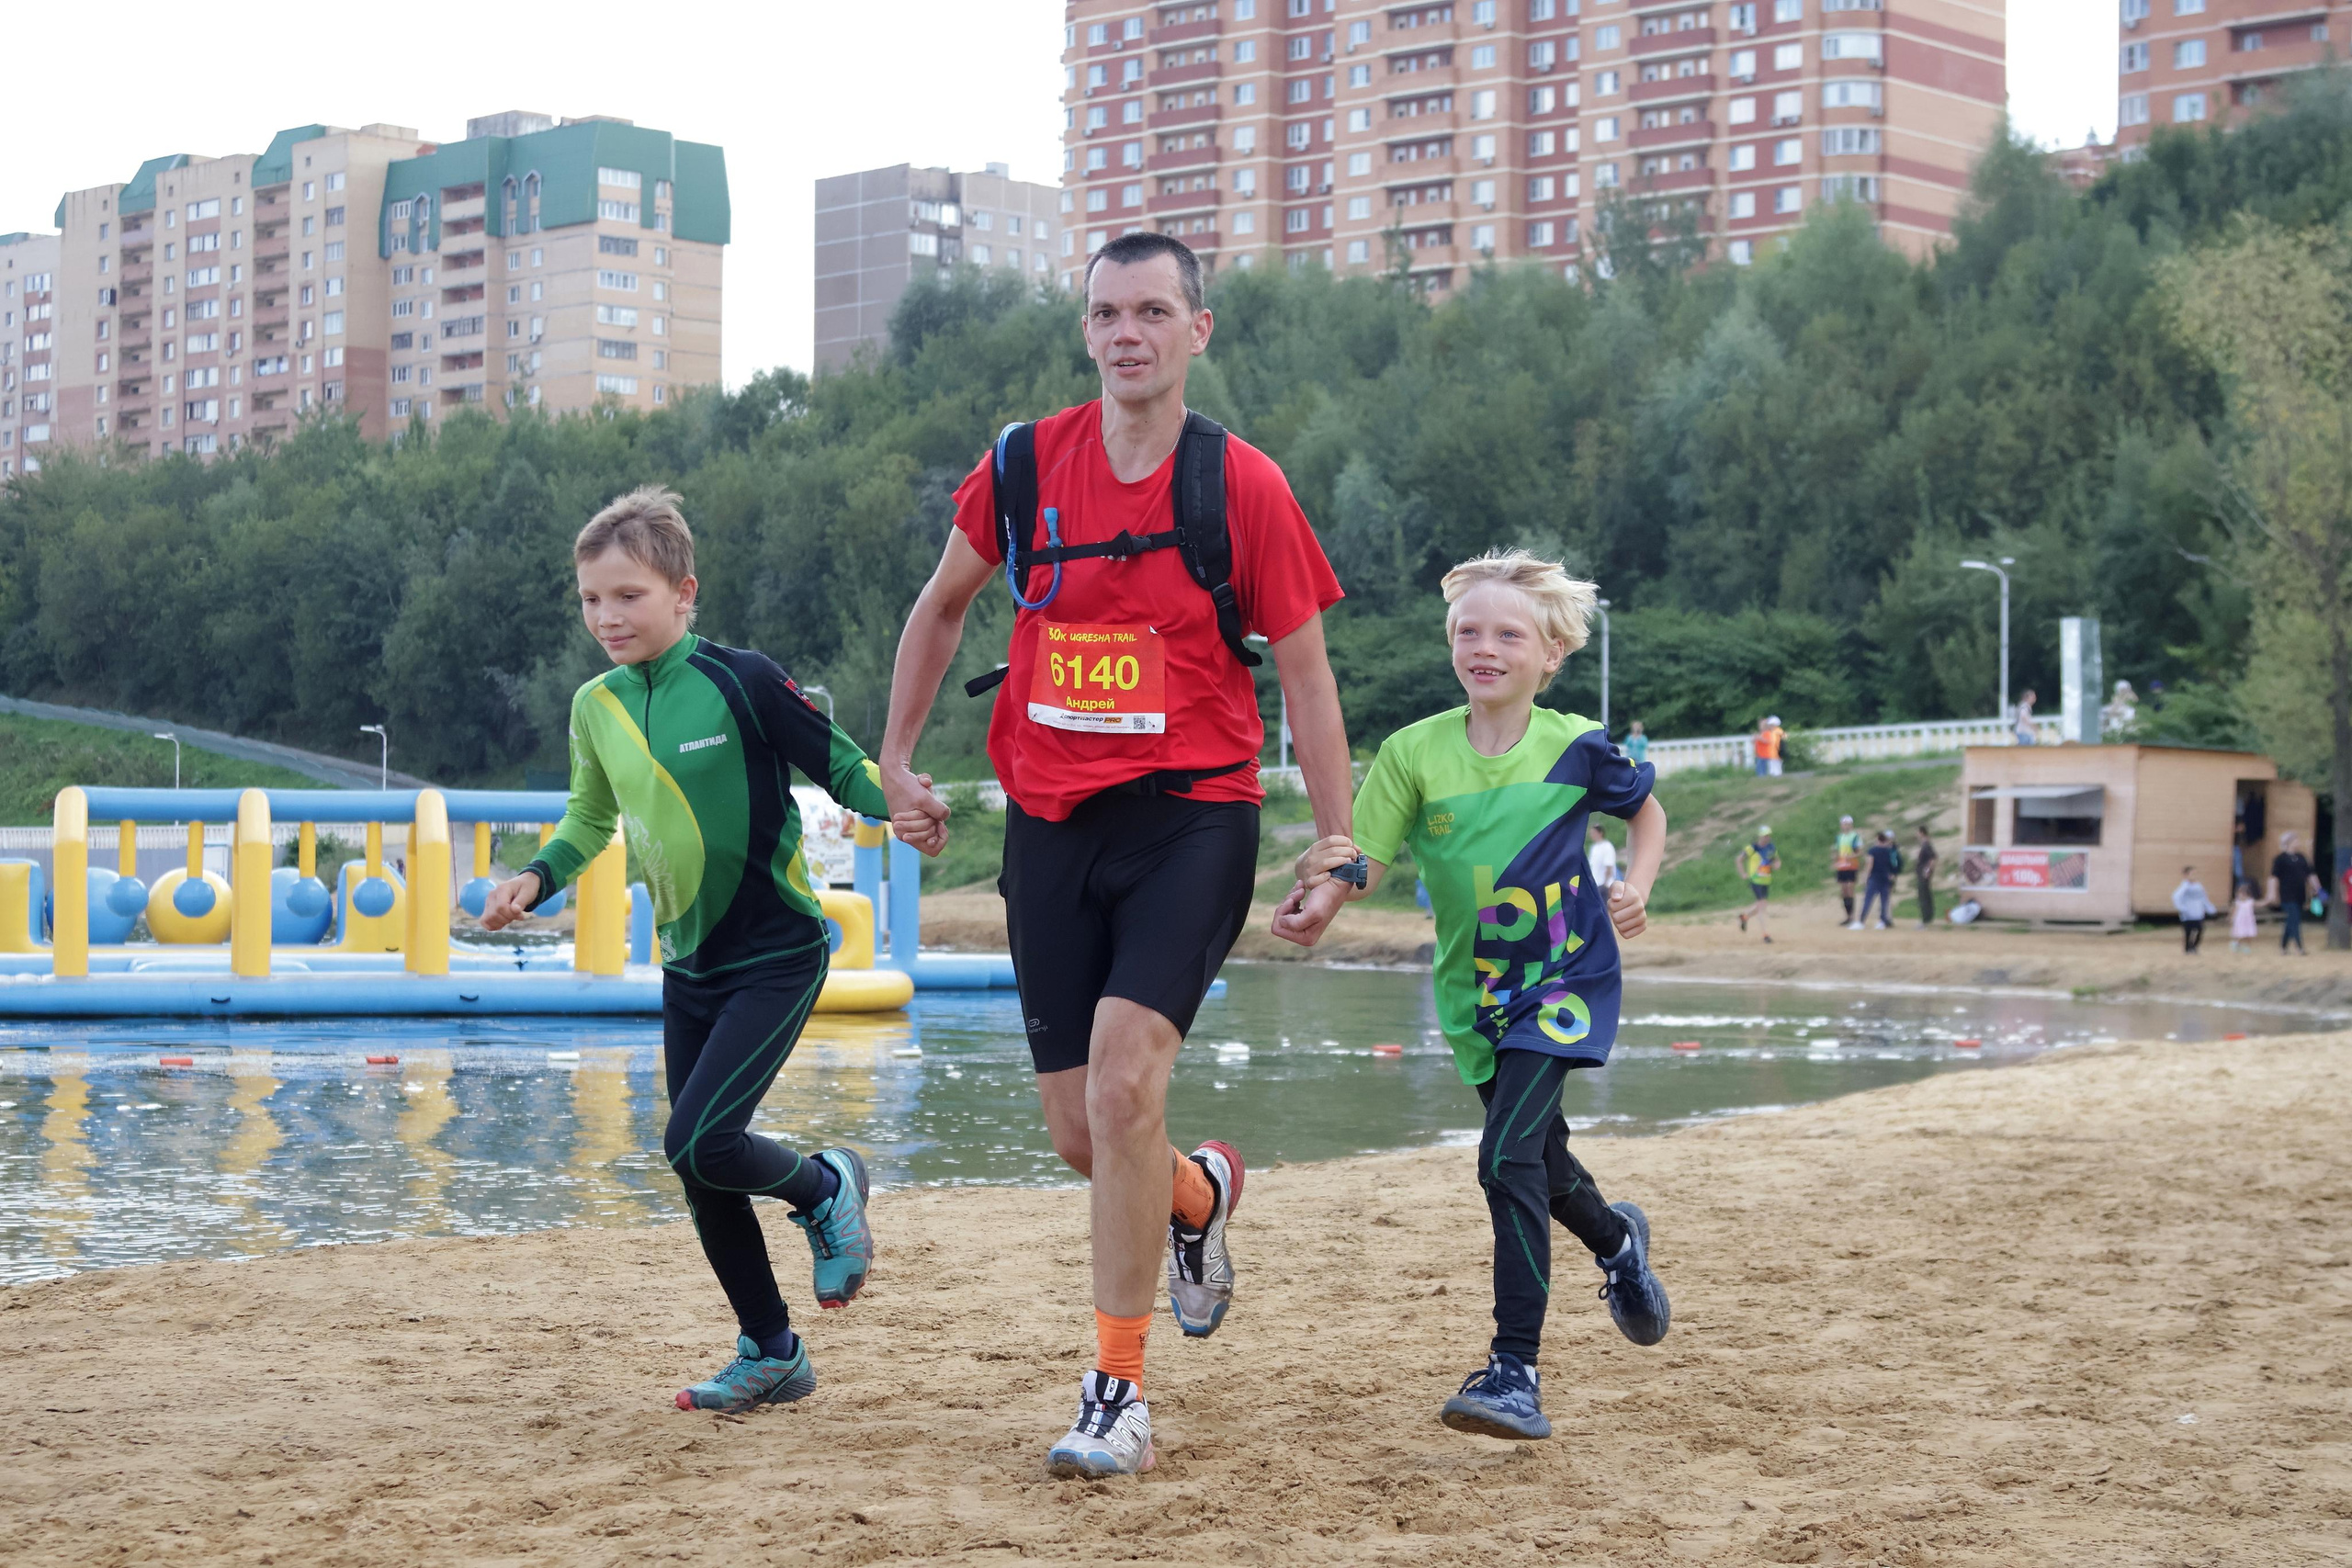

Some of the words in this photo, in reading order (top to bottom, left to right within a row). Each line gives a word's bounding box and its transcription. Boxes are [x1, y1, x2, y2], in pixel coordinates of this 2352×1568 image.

[1047, 627, 1067, 642] 30K
[1069, 633, 1111, 643] UGRESHA
[1113, 633, 1137, 642] TRAIL
[1050, 652, 1140, 691] 6140
[1066, 695, 1115, 711] Андрей
[679, 734, 728, 753] АТЛАНТИДА
[1428, 824, 1453, 836] TRAIL
